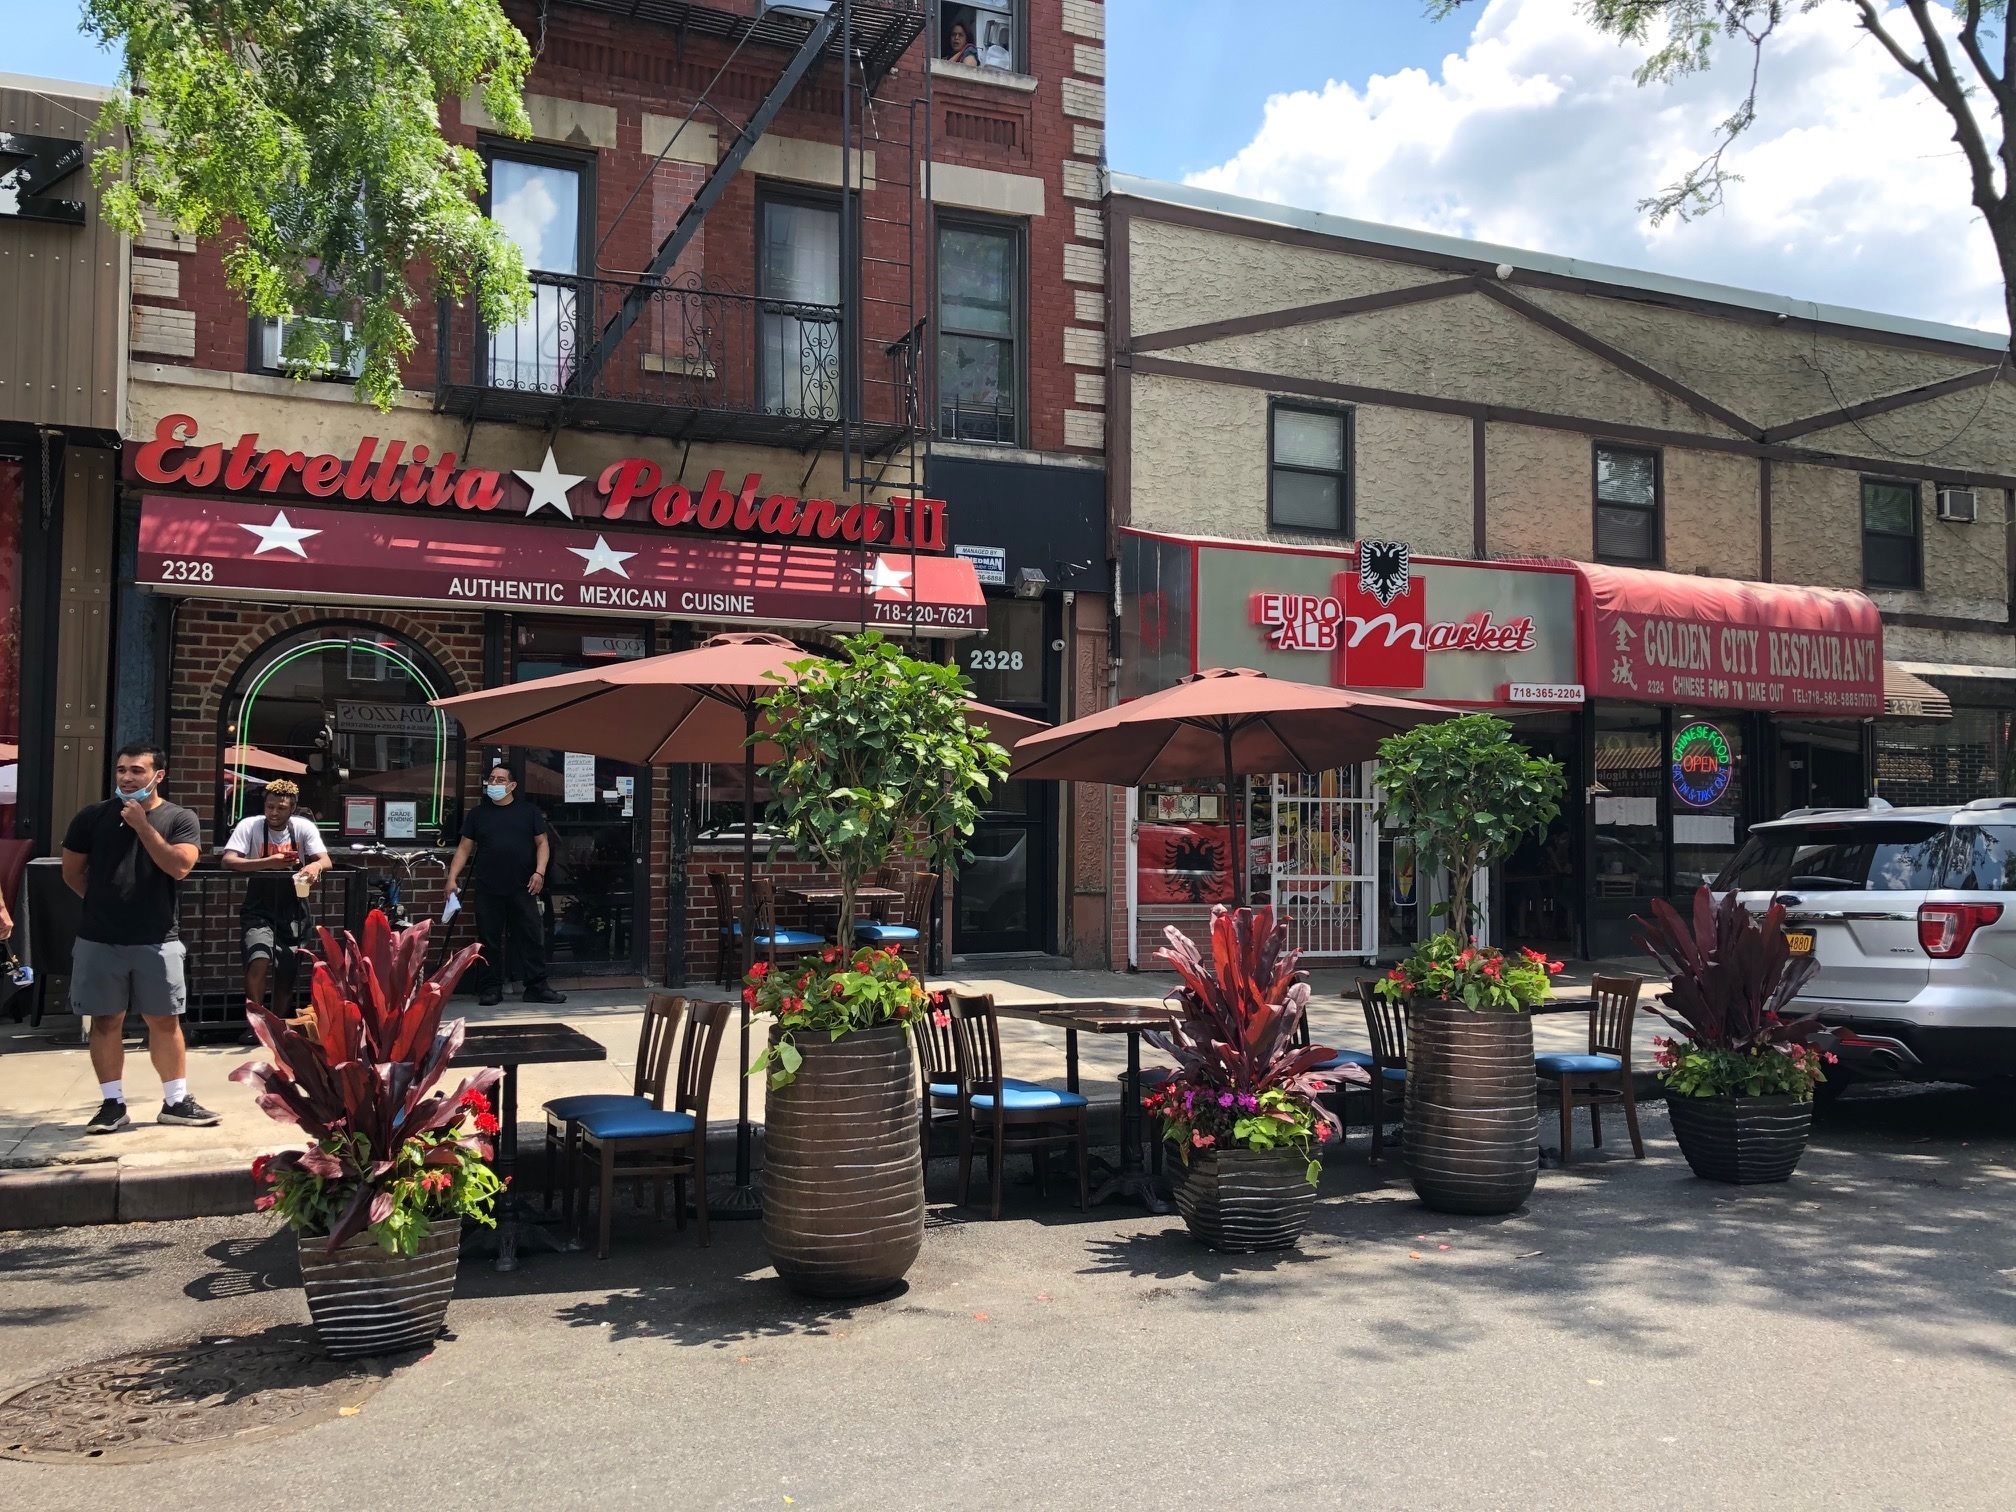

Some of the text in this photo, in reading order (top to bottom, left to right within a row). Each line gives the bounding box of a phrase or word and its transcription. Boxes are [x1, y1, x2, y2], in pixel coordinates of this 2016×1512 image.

[134, 412, 506, 511] Estrellita
[597, 457, 886, 543] Poblana
[962, 547, 989, 555] MANAGED
[160, 560, 215, 582] 2328
[448, 576, 755, 615] AUTHENTIC MEXICAN CUISINE
[1262, 594, 1341, 624] EURO
[872, 602, 975, 625] 718-220-7621
[1279, 620, 1336, 649] ALB
[969, 649, 1024, 671] 2328
[1644, 618, 1876, 683] GOLDEN CITY RESTAURANT
[1512, 687, 1582, 699] 718-365-2204
[1647, 679, 1665, 694] 2324
[1672, 675, 1706, 698] CHINESE
[1732, 680, 1743, 701] TO
[1746, 681, 1767, 702] TAKE
[1769, 682, 1785, 703] OUT
[1672, 725, 1729, 764] CHINESE FOOD
[1683, 754, 1718, 773] OPEN
[1672, 763, 1684, 782] EAT
[1678, 781, 1690, 794] IN
[1696, 785, 1717, 802] TAKE
[1714, 766, 1729, 789] OUT
